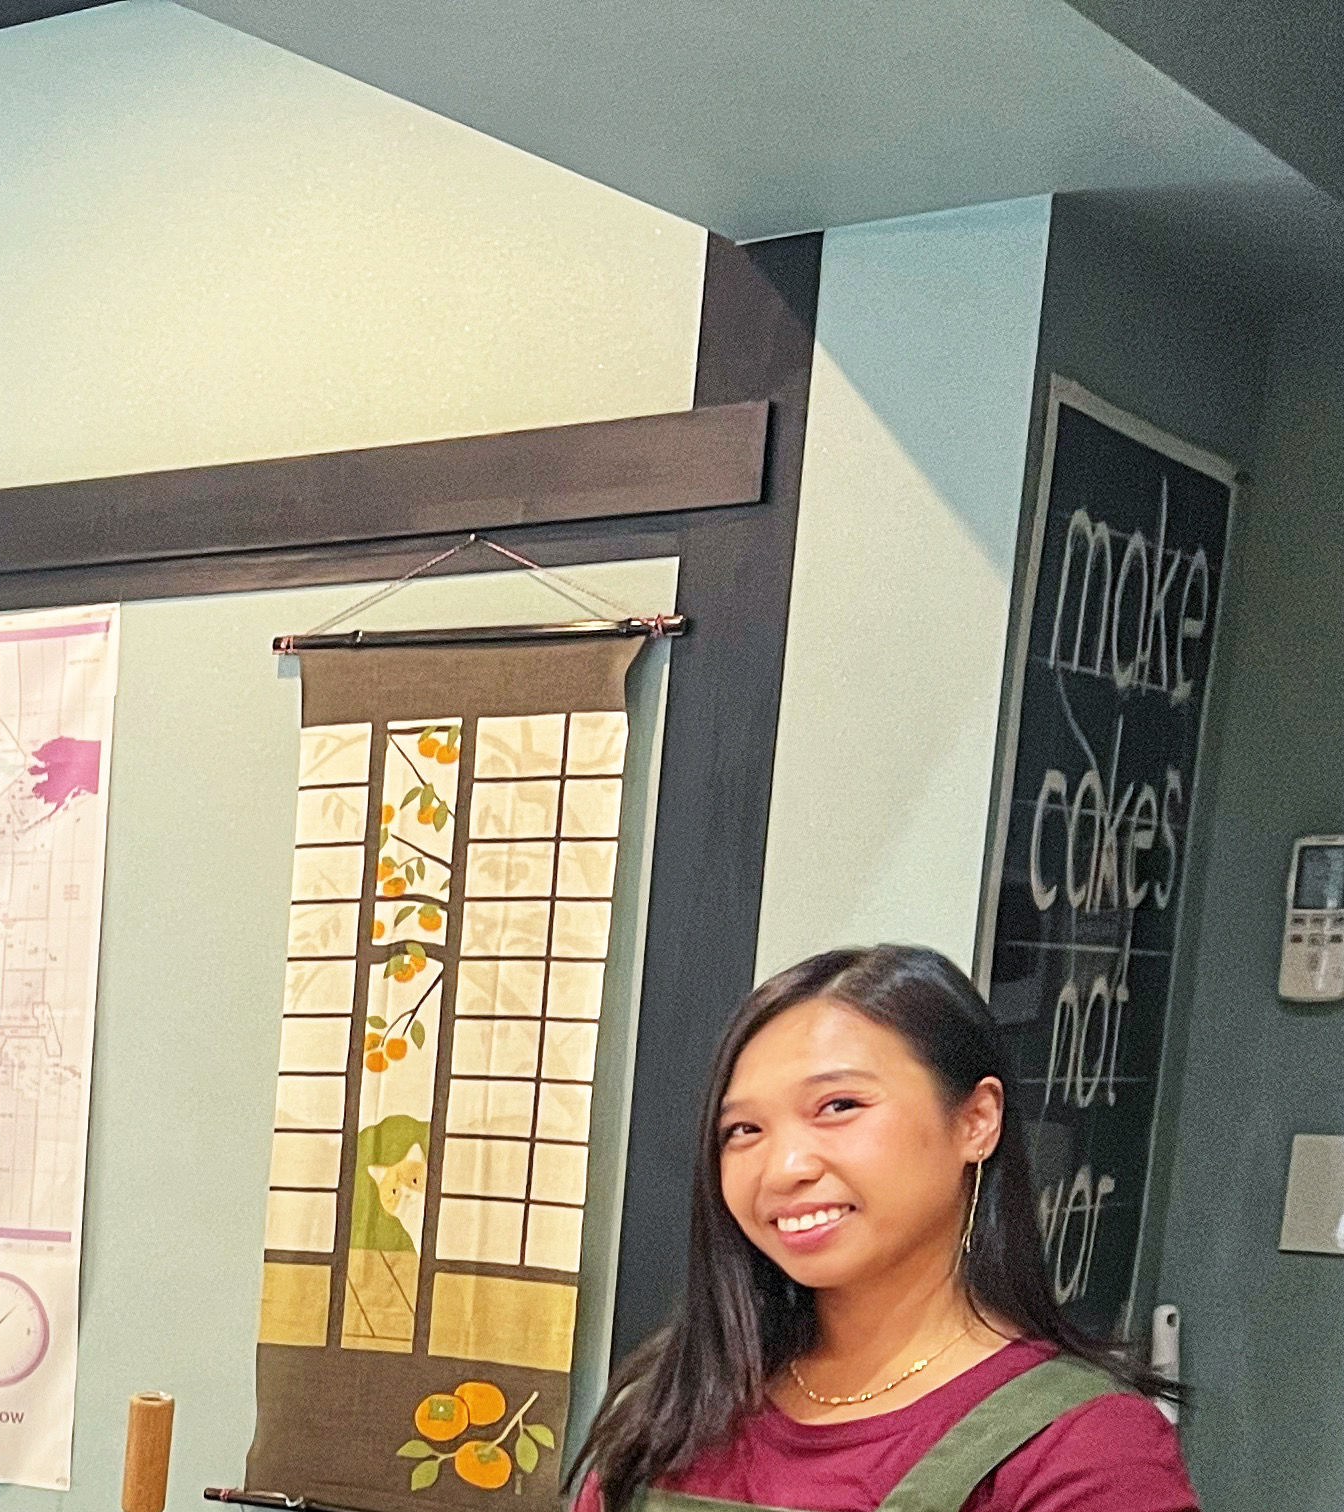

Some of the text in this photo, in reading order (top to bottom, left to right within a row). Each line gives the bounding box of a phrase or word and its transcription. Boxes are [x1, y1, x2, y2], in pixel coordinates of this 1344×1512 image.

[1048, 476, 1210, 707] make
[1030, 714, 1184, 914] cakes
[1045, 908, 1133, 1109] not
